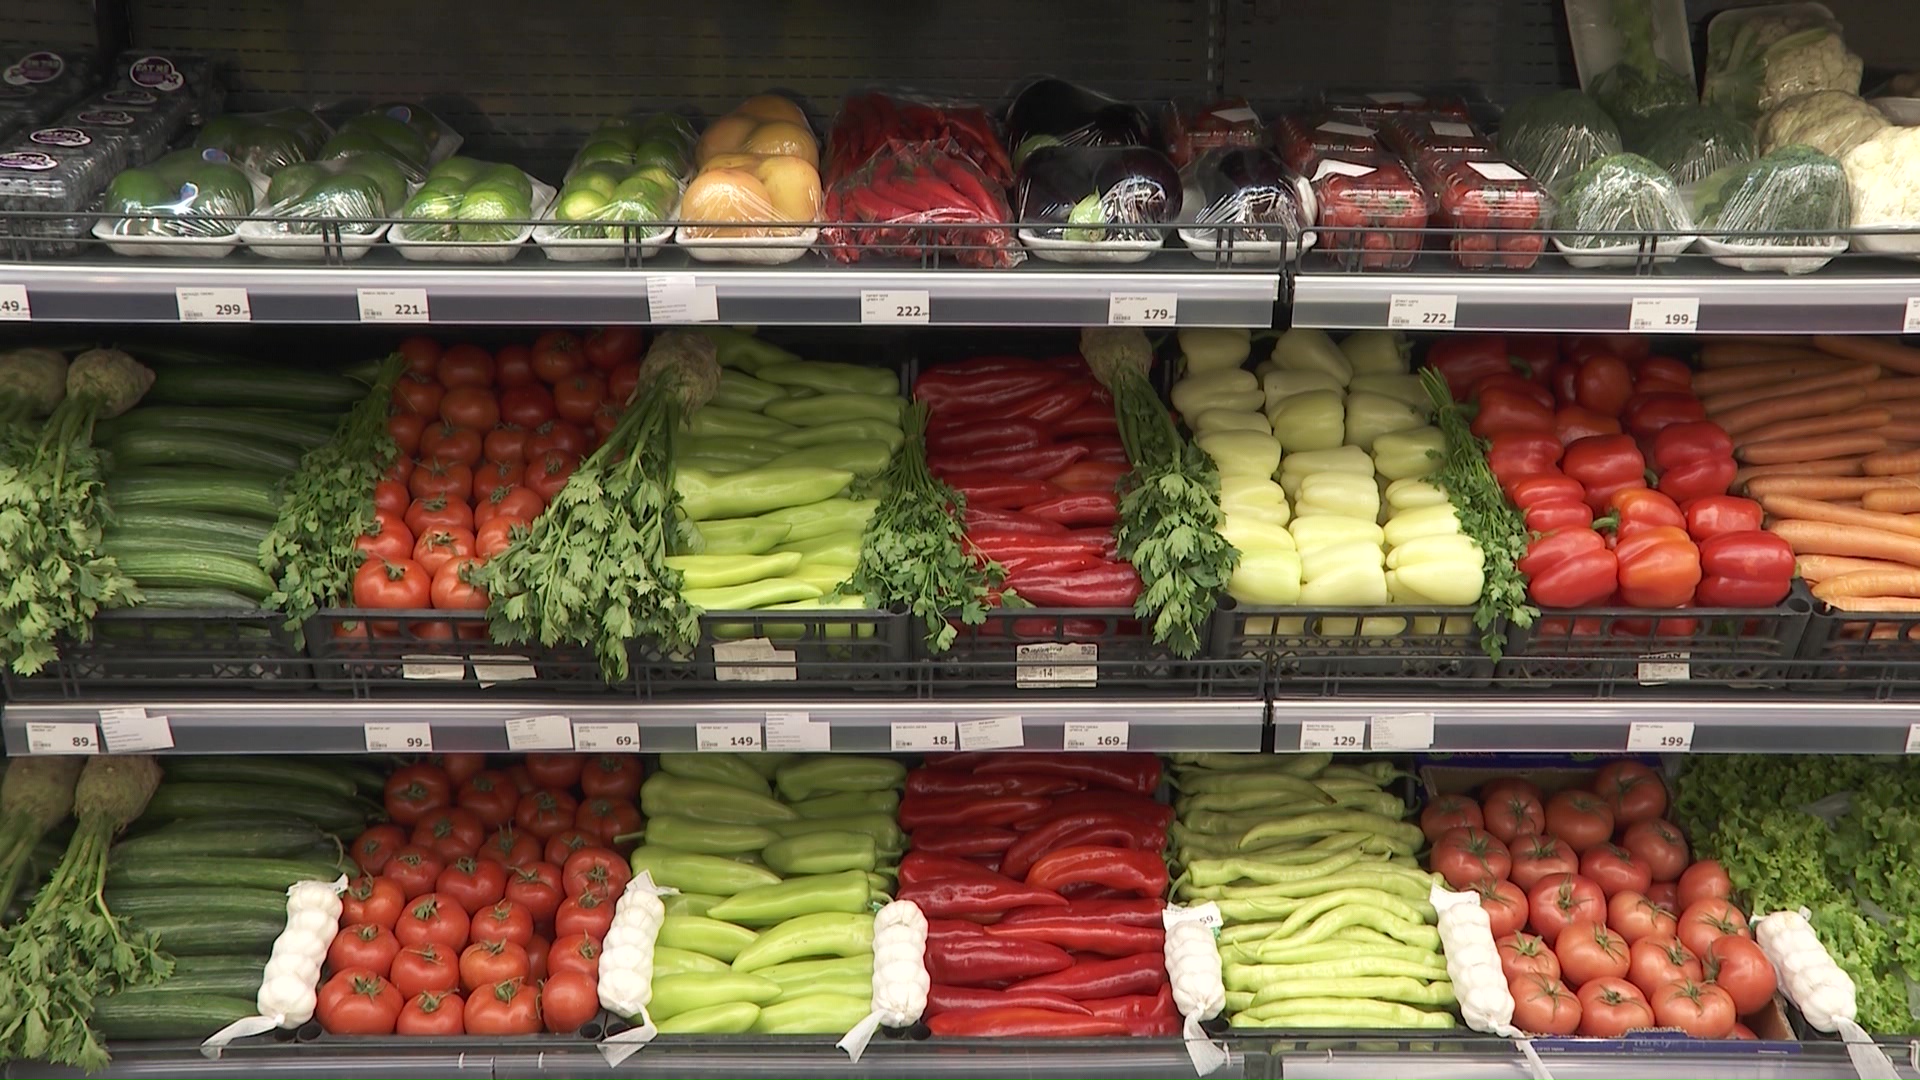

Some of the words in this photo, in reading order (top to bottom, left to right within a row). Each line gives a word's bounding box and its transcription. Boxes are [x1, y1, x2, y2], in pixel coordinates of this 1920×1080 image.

[135, 63, 154, 72] EAT
[156, 63, 170, 72] ME
[0, 300, 20, 312] 49
[215, 304, 241, 316] 299
[394, 304, 420, 315] 221
[896, 306, 921, 317] 222
[1143, 308, 1168, 320] 179
[1422, 312, 1447, 324] 272
[1664, 313, 1689, 325] 199
[72, 736, 89, 747] 89
[406, 737, 423, 748] 99
[616, 735, 632, 746] 69
[730, 736, 753, 746] 149
[932, 735, 948, 745] 18
[1097, 735, 1120, 746] 169
[1333, 736, 1356, 746] 129
[1660, 736, 1684, 747] 199
